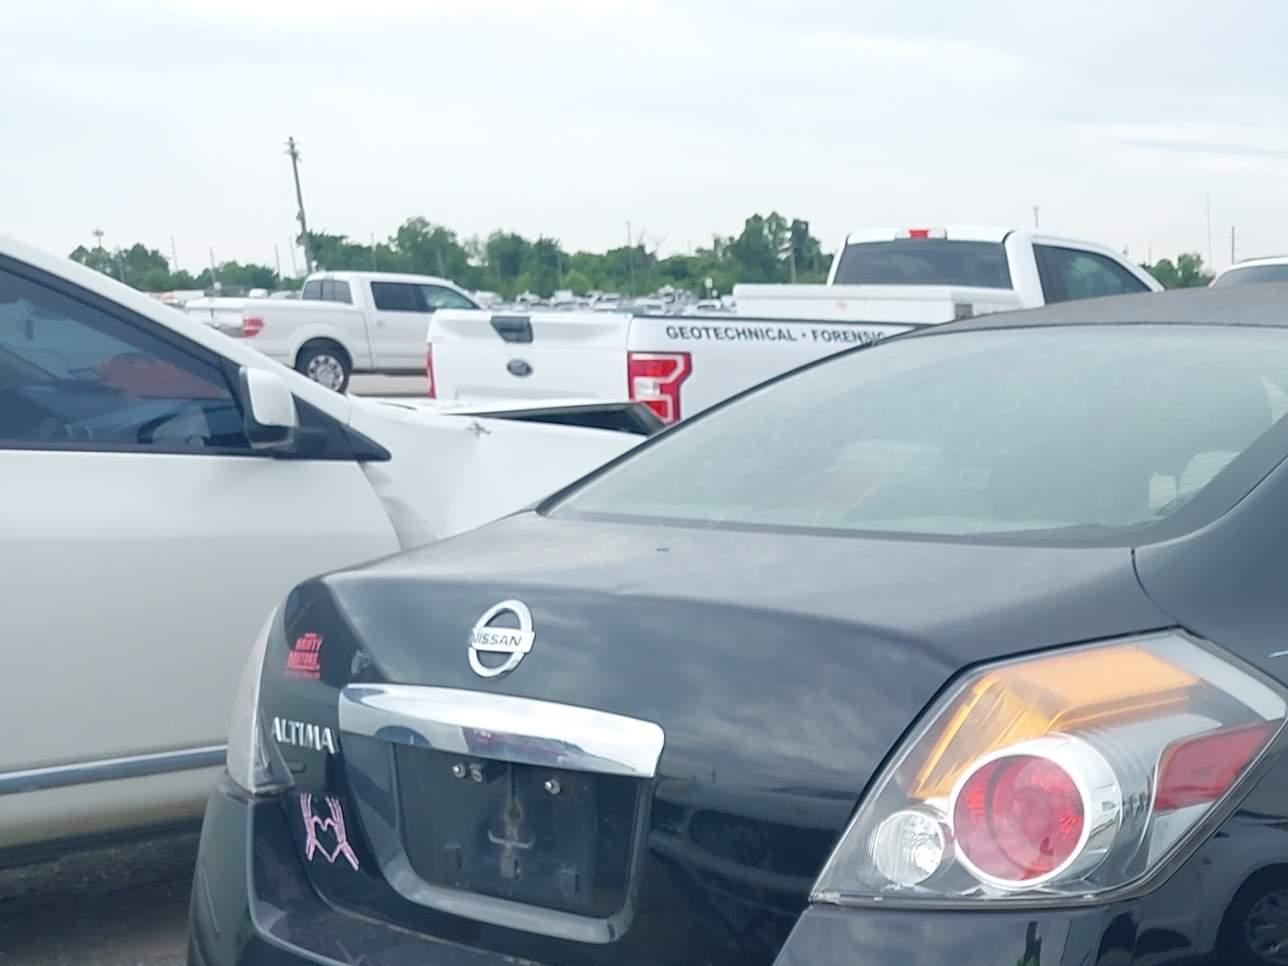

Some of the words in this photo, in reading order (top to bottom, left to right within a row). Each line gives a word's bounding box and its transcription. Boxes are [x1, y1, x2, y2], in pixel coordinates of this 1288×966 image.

[666, 325, 797, 342] GEOTECHNICAL
[474, 629, 522, 647] NISSAN
[271, 716, 339, 755] ALTIMA
